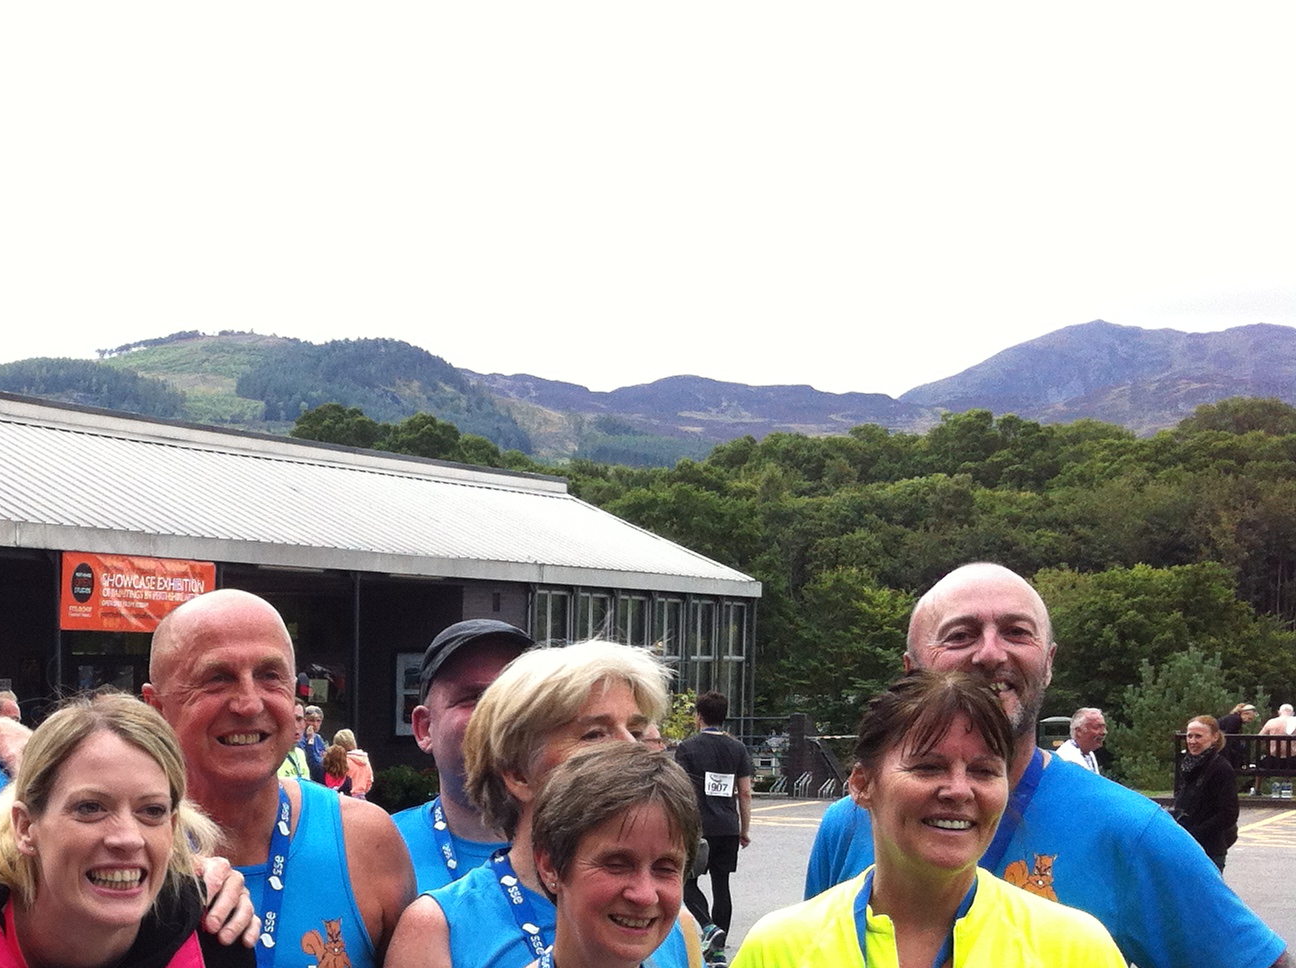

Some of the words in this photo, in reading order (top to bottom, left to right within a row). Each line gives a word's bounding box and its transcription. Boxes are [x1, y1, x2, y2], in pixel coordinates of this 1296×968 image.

[101, 573, 156, 590] SHOWCASE
[157, 576, 205, 593] EXHIBITION
[708, 782, 728, 792] 1907
[272, 854, 285, 876] sse
[264, 911, 276, 933] sse
